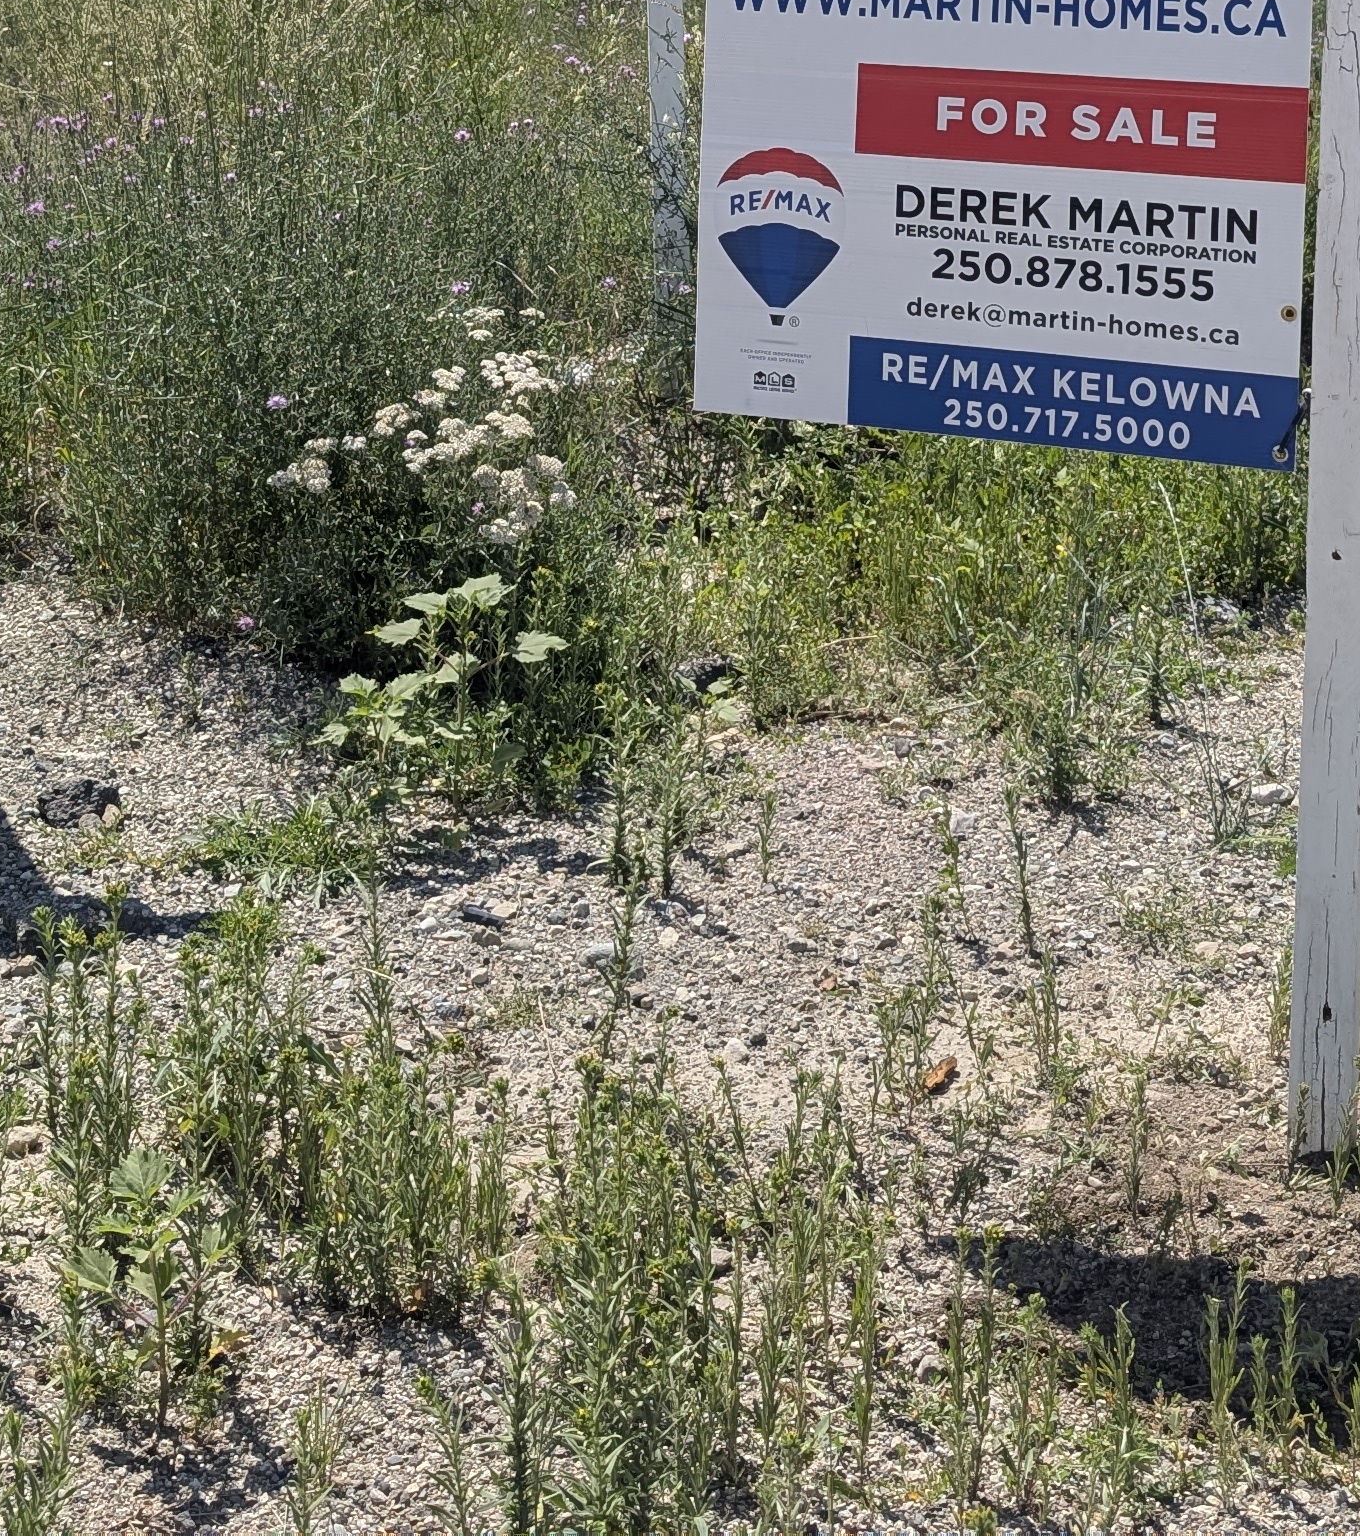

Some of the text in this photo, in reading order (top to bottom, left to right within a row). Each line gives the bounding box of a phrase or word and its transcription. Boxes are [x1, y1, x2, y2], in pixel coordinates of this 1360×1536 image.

[936, 96, 1218, 149] FOR SALE
[730, 189, 832, 224] RE/MAX
[895, 183, 1259, 246] DEREK MARTIN
[894, 223, 1257, 265] PERSONAL REAL ESTATE CORPORATION
[931, 247, 1215, 302] 250.878.1555
[906, 296, 1240, 346] derek@martin-homes.ca
[881, 352, 1262, 419] RE/MAX KELOWNA
[942, 398, 1191, 451] 250.717.5000
